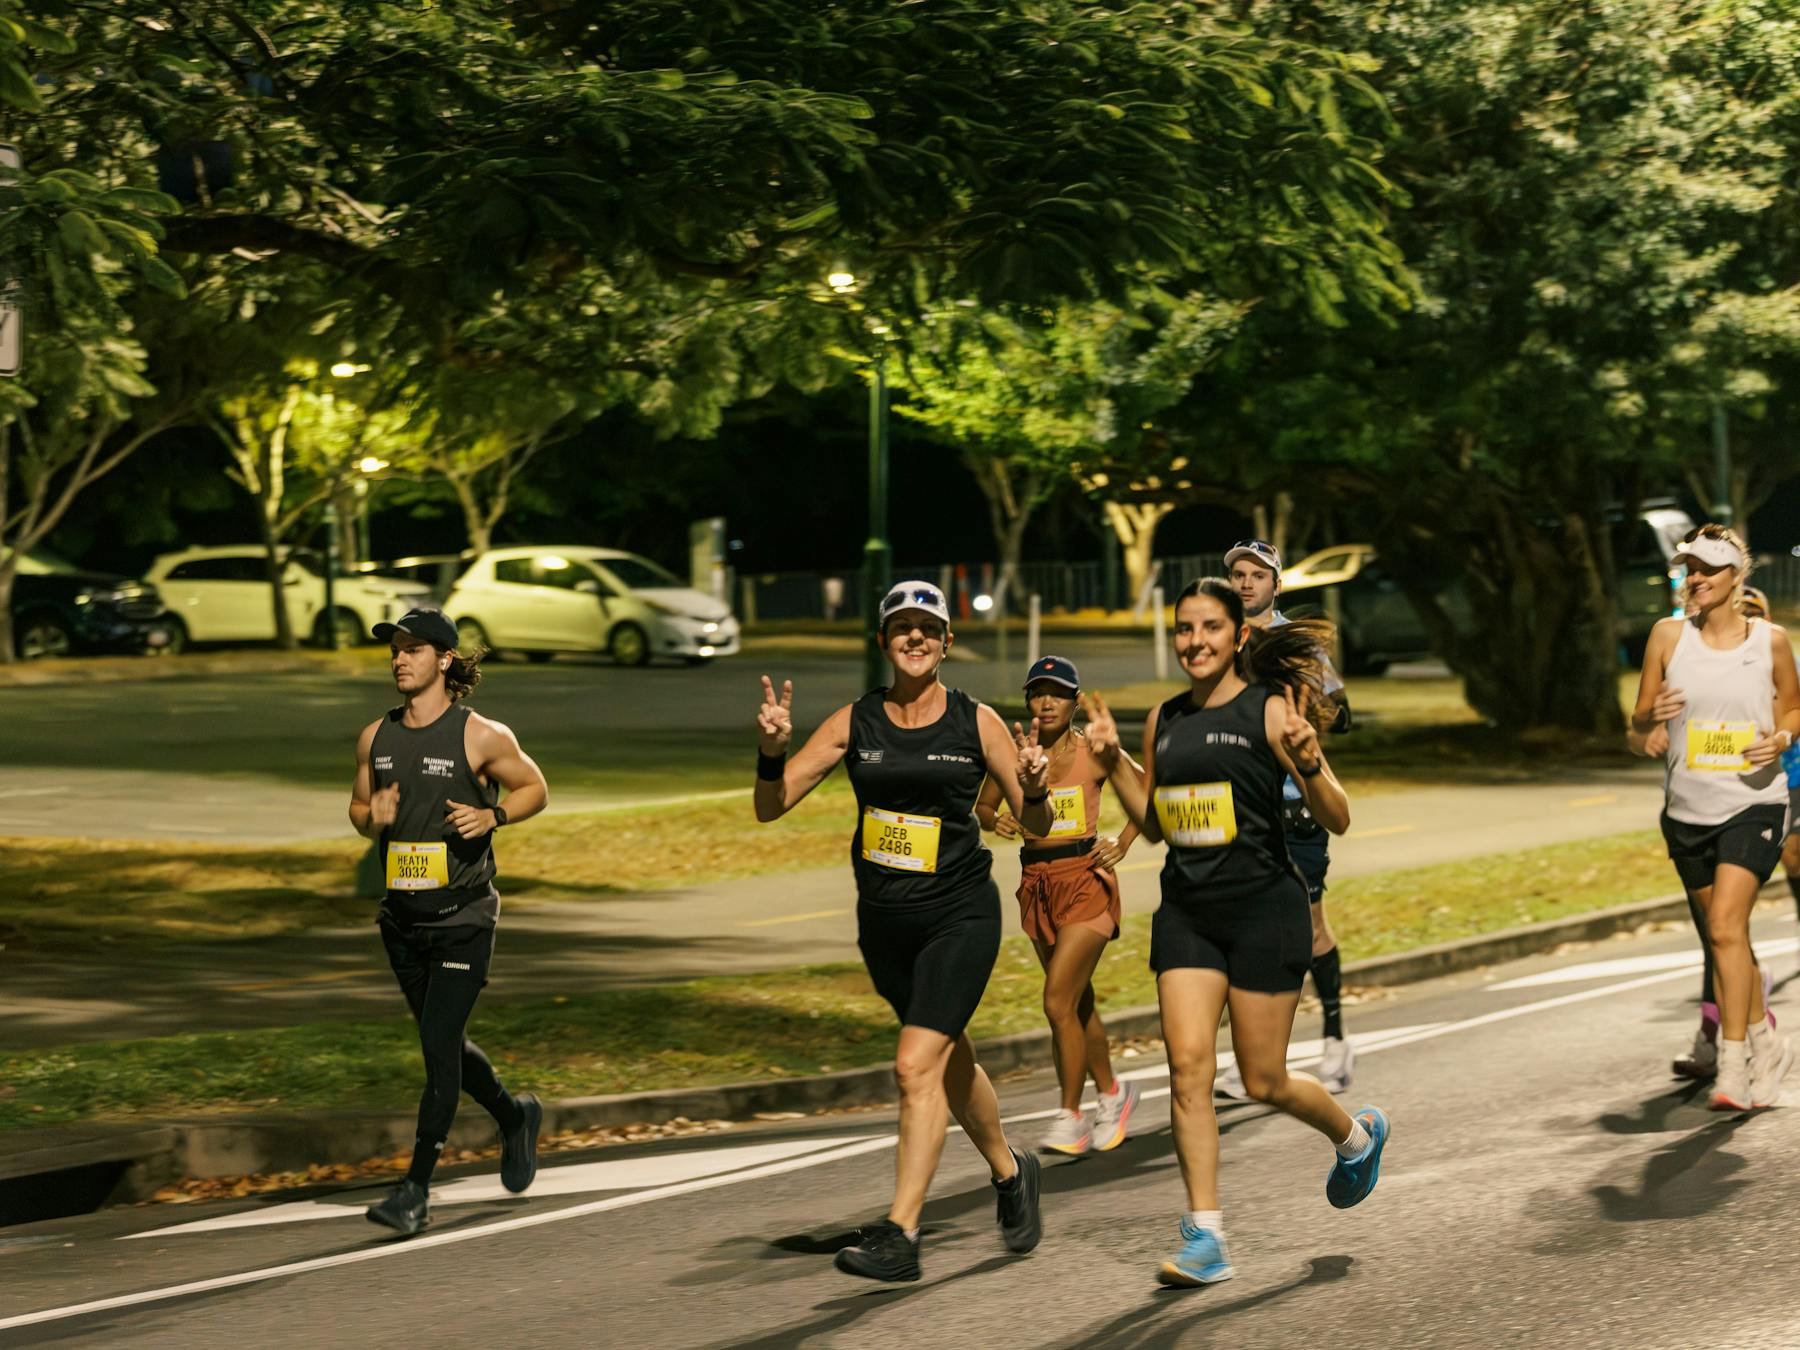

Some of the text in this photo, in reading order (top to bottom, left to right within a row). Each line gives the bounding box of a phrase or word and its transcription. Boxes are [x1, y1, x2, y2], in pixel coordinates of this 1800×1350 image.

[423, 756, 455, 769] RUNNING
[1167, 800, 1218, 818] MELANIE
[884, 825, 908, 840] DEB
[879, 837, 912, 856] 2486
[397, 855, 429, 866] HEATH
[398, 866, 428, 879] 3032
